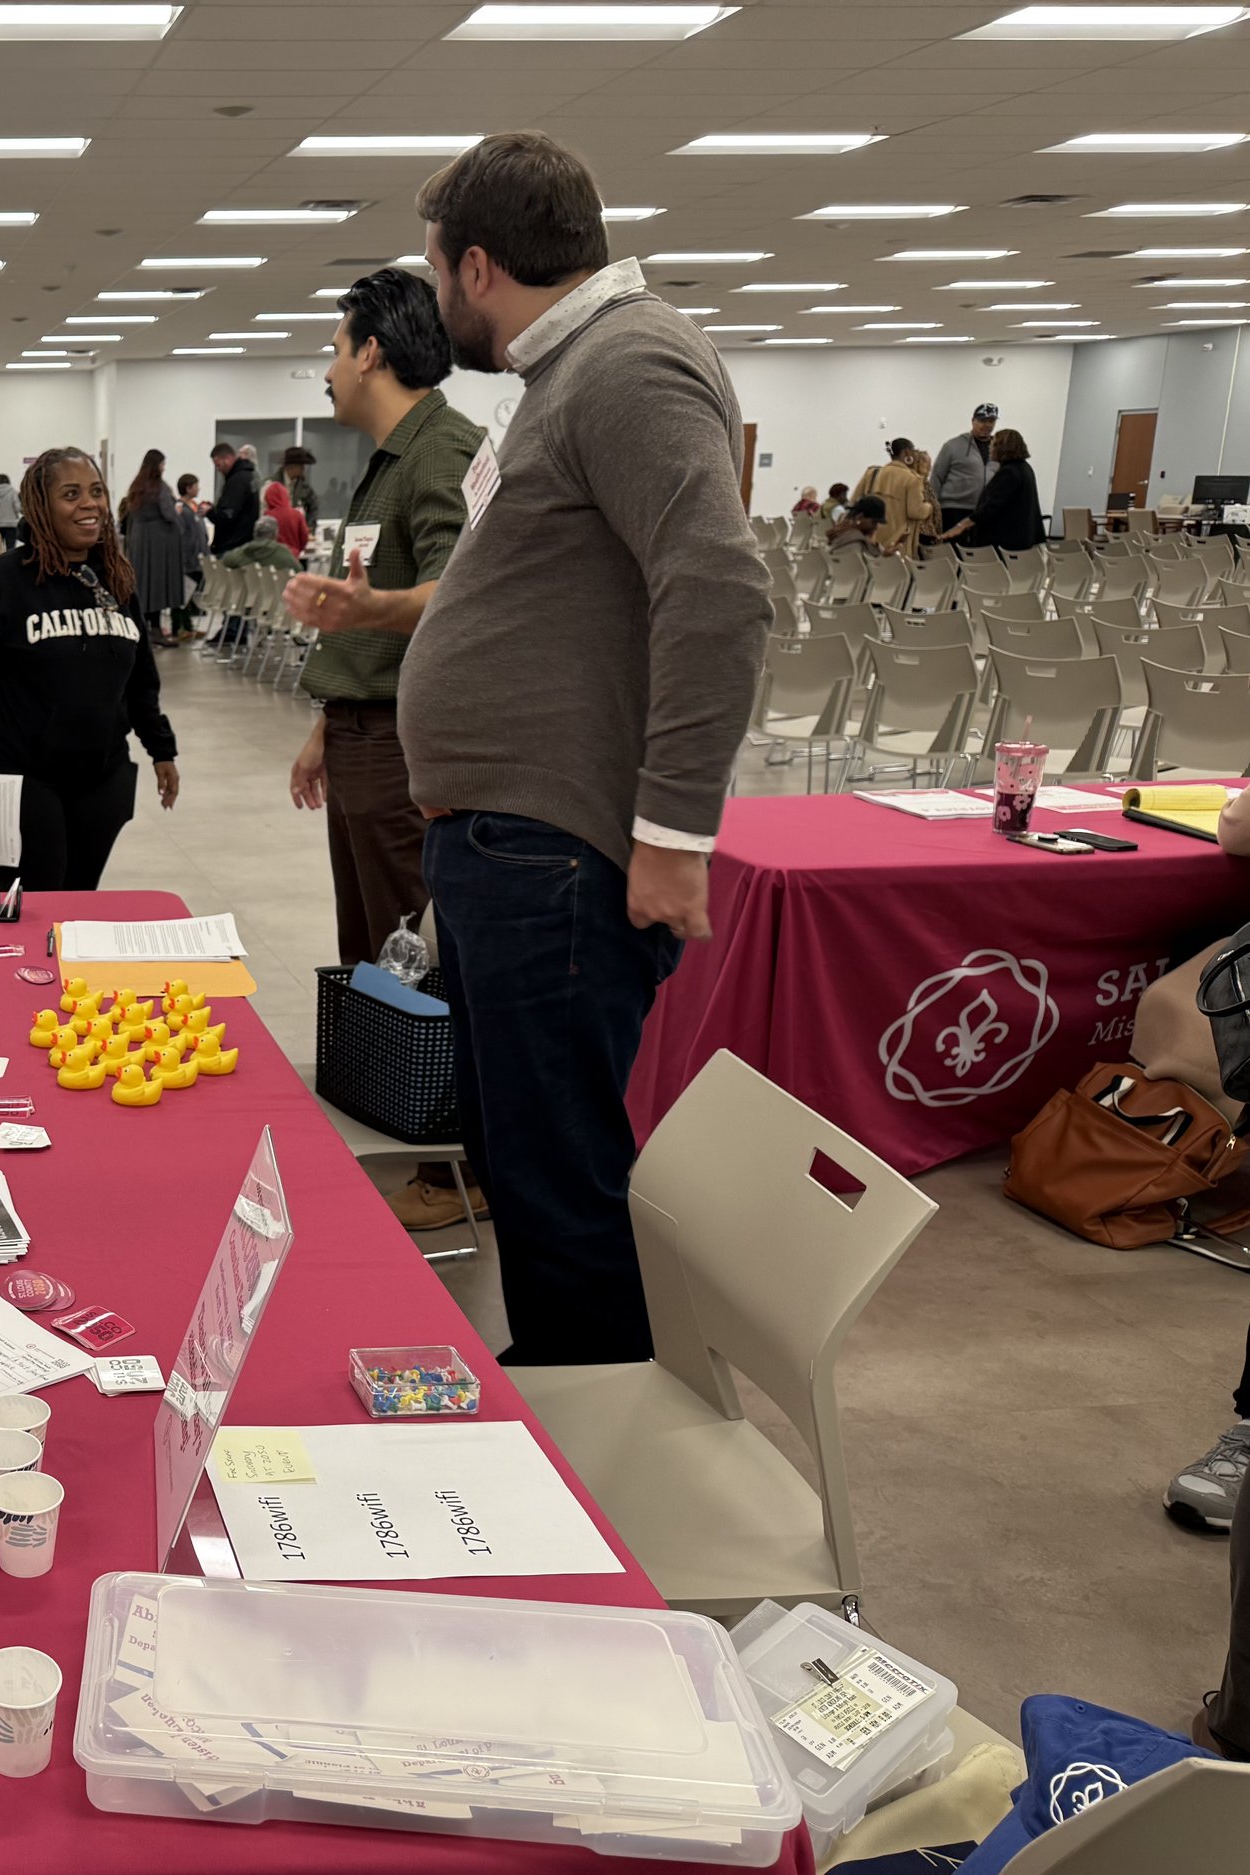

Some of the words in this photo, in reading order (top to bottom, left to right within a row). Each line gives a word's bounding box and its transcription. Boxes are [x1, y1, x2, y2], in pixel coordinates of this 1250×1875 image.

[24, 1279, 34, 1297] COUNTY
[32, 1279, 46, 1296] 2050
[258, 1496, 306, 1560] 1786wifi
[356, 1492, 410, 1559] 1786wifi
[434, 1490, 493, 1556] 1786wifi
[815, 1742, 826, 1751] GEN
